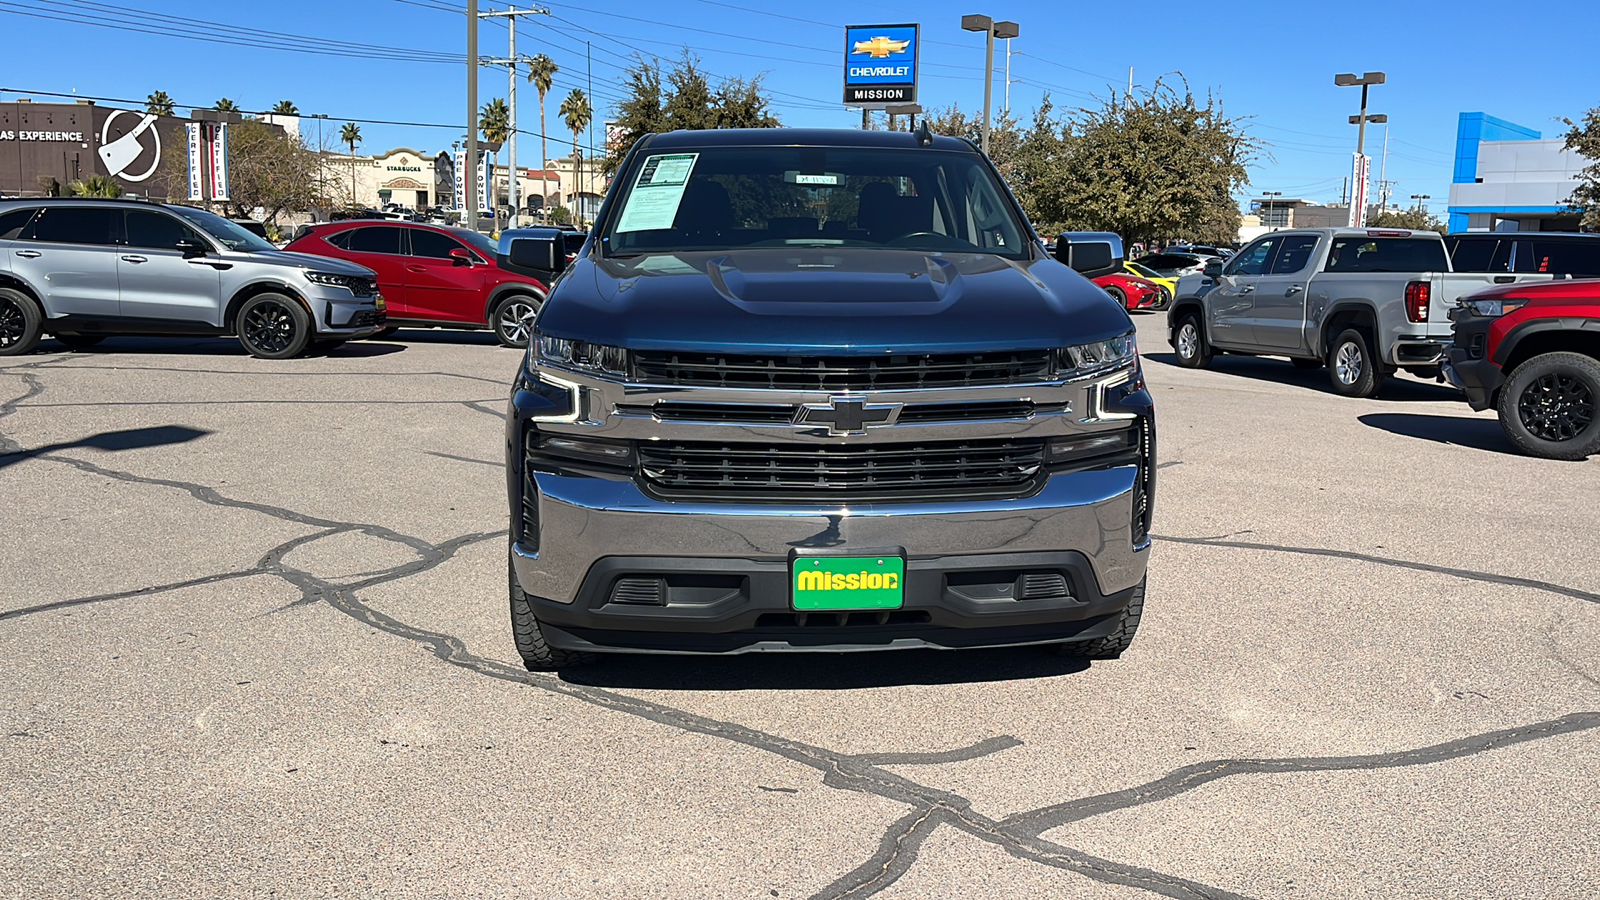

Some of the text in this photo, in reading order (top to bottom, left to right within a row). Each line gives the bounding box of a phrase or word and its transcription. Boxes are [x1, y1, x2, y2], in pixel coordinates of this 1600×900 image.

[850, 66, 909, 77] CHEVROLET
[854, 89, 903, 99] MISSION
[19, 131, 83, 141] EXPERIENCE
[191, 126, 199, 196] CERTIFIED
[215, 125, 224, 196] CERTIFIED
[797, 570, 898, 591] Mission
